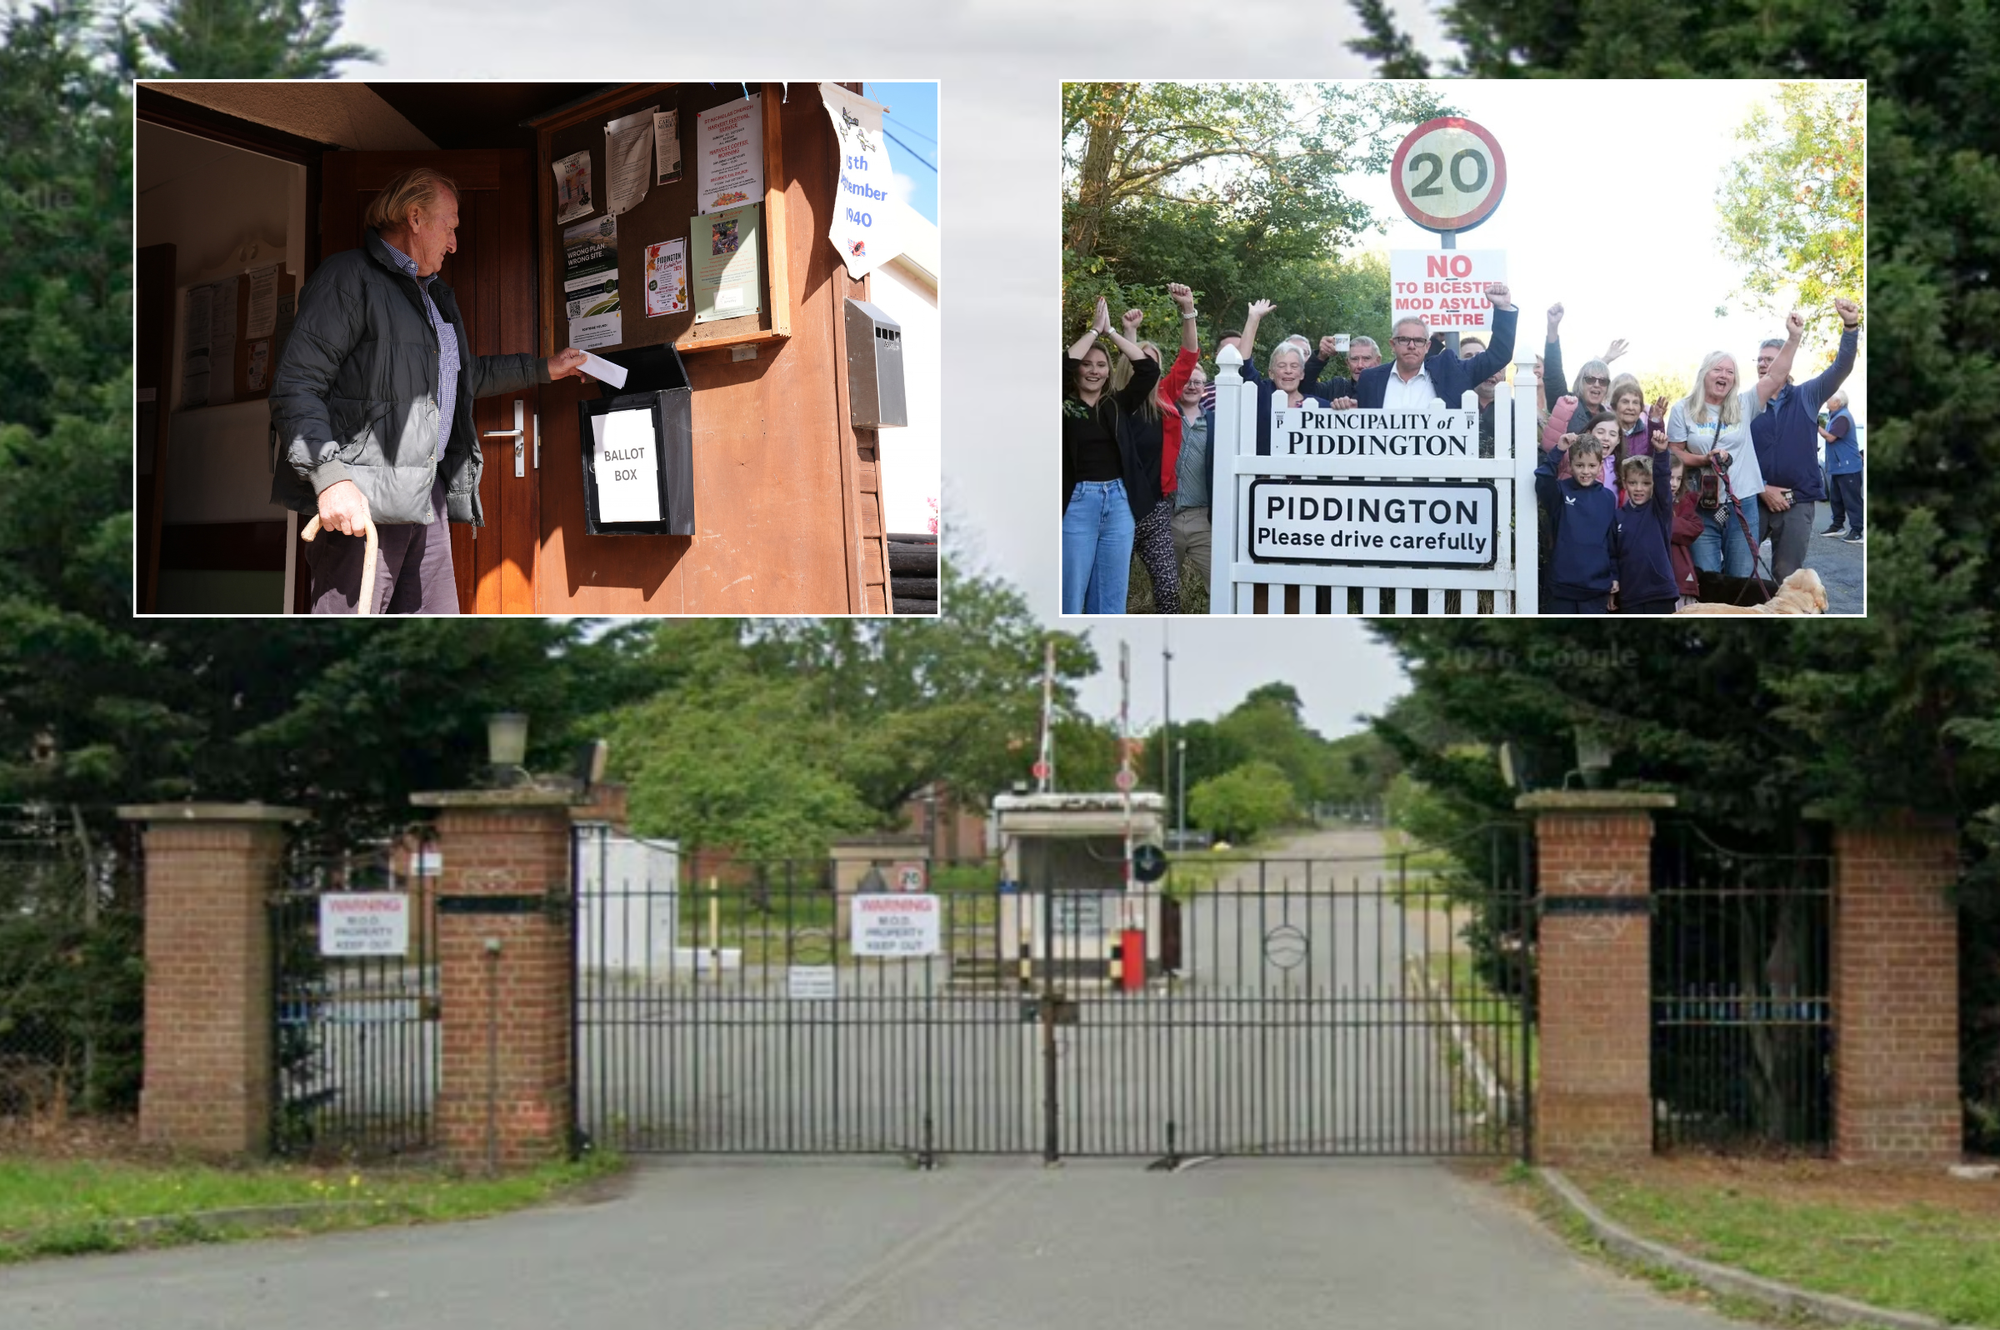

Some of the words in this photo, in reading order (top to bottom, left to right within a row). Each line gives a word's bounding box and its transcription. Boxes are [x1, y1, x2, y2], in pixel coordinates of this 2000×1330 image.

[1409, 148, 1488, 198] 20
[846, 207, 872, 228] 1940
[567, 247, 590, 259] WRONG
[568, 255, 590, 266] WRONG
[1427, 255, 1472, 278] NO
[1395, 282, 1418, 294] TO
[1424, 282, 1502, 294] BICESTE
[1395, 298, 1434, 310] MOD
[1439, 298, 1494, 310] ASYLU
[1419, 313, 1484, 326] CENTRE
[1300, 411, 1432, 429] PRINCIPALITY
[1437, 416, 1455, 430] of
[1287, 431, 1468, 456] PIDDINGTON
[604, 447, 645, 462] BALLOT
[614, 469, 638, 481] BOX
[1267, 496, 1478, 525] PIDDINGTON
[1258, 527, 1325, 546] Please
[1331, 530, 1384, 548] drive
[1390, 532, 1487, 554] carefully
[860, 899, 933, 912] WARNING
[865, 927, 925, 937] PROPERTY
[866, 941, 897, 951] KEEP
[901, 941, 924, 951] OUT
